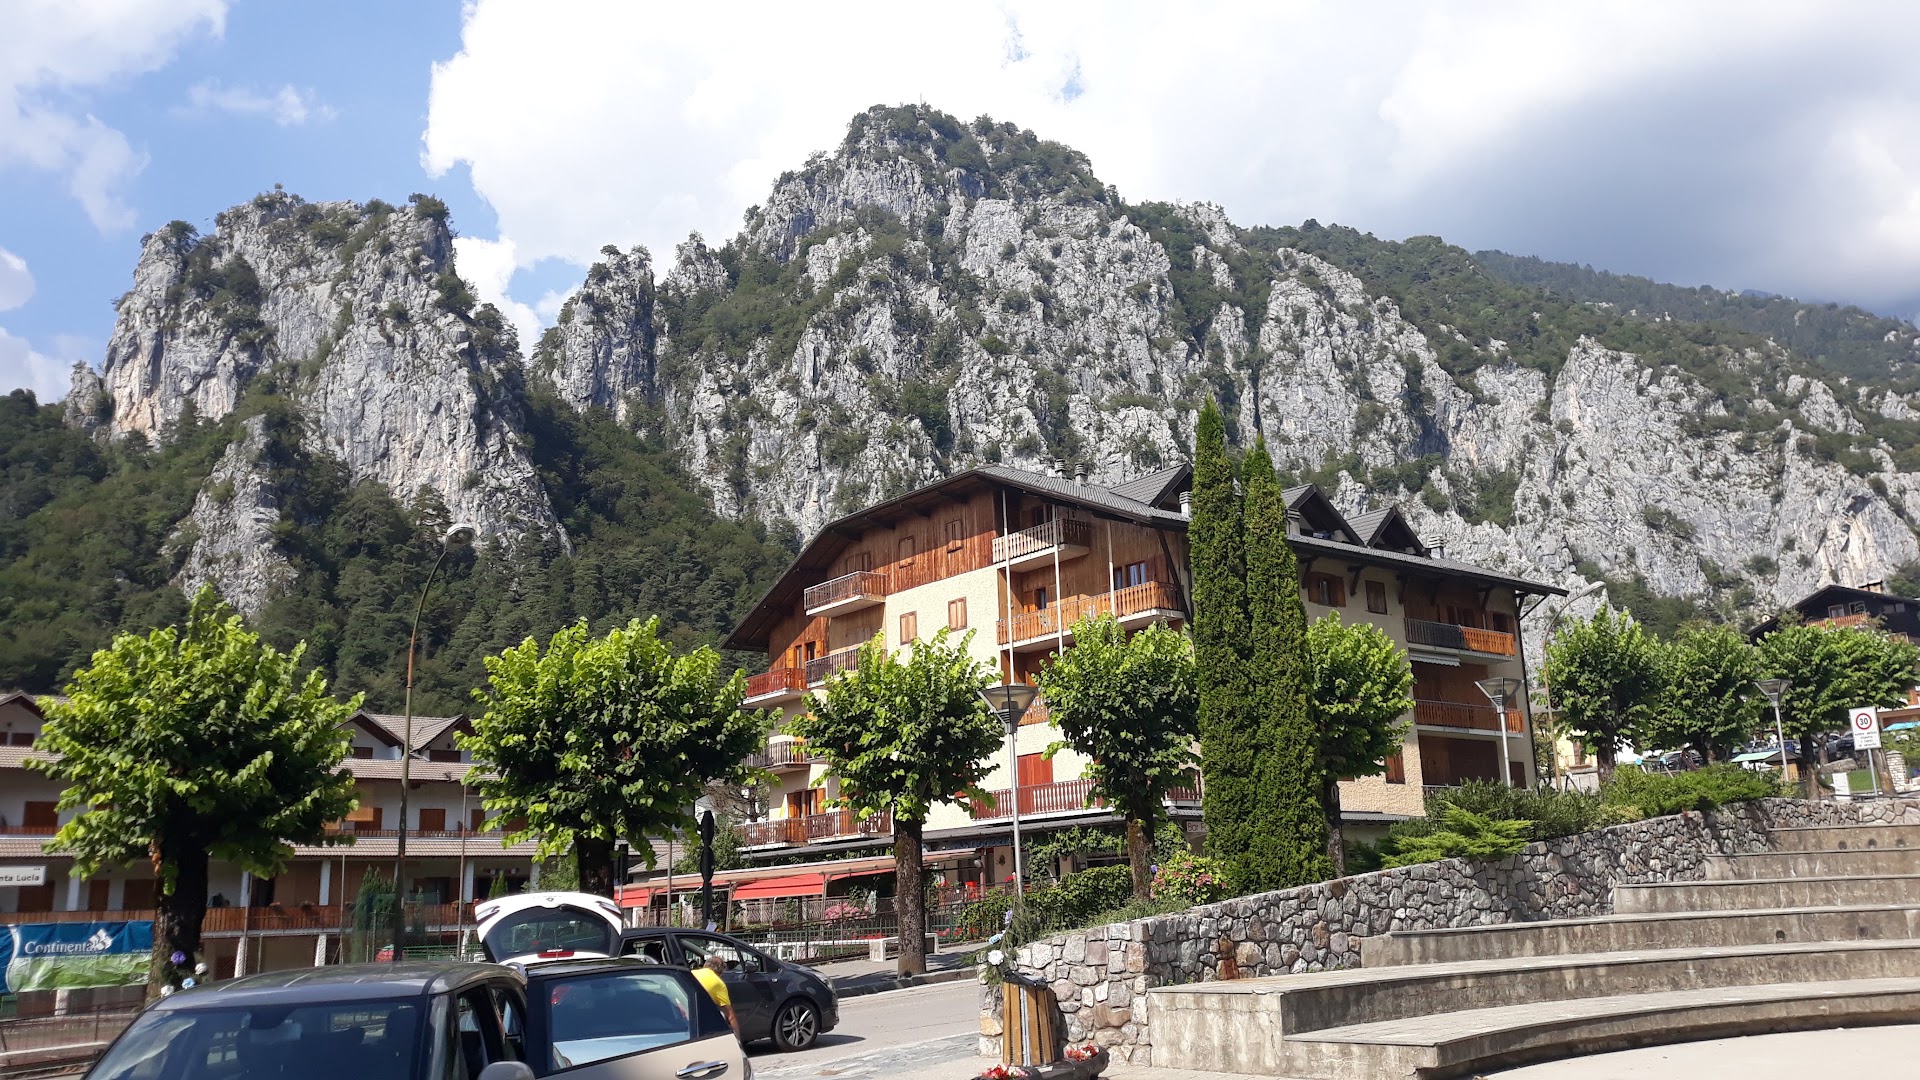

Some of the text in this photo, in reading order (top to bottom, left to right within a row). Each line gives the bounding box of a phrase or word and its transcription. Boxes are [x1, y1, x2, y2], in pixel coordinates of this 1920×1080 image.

[1859, 717, 1868, 725] 30
[1188, 822, 1199, 831] Bar
[16, 874, 40, 882] Lucia
[24, 940, 97, 954] Continental
